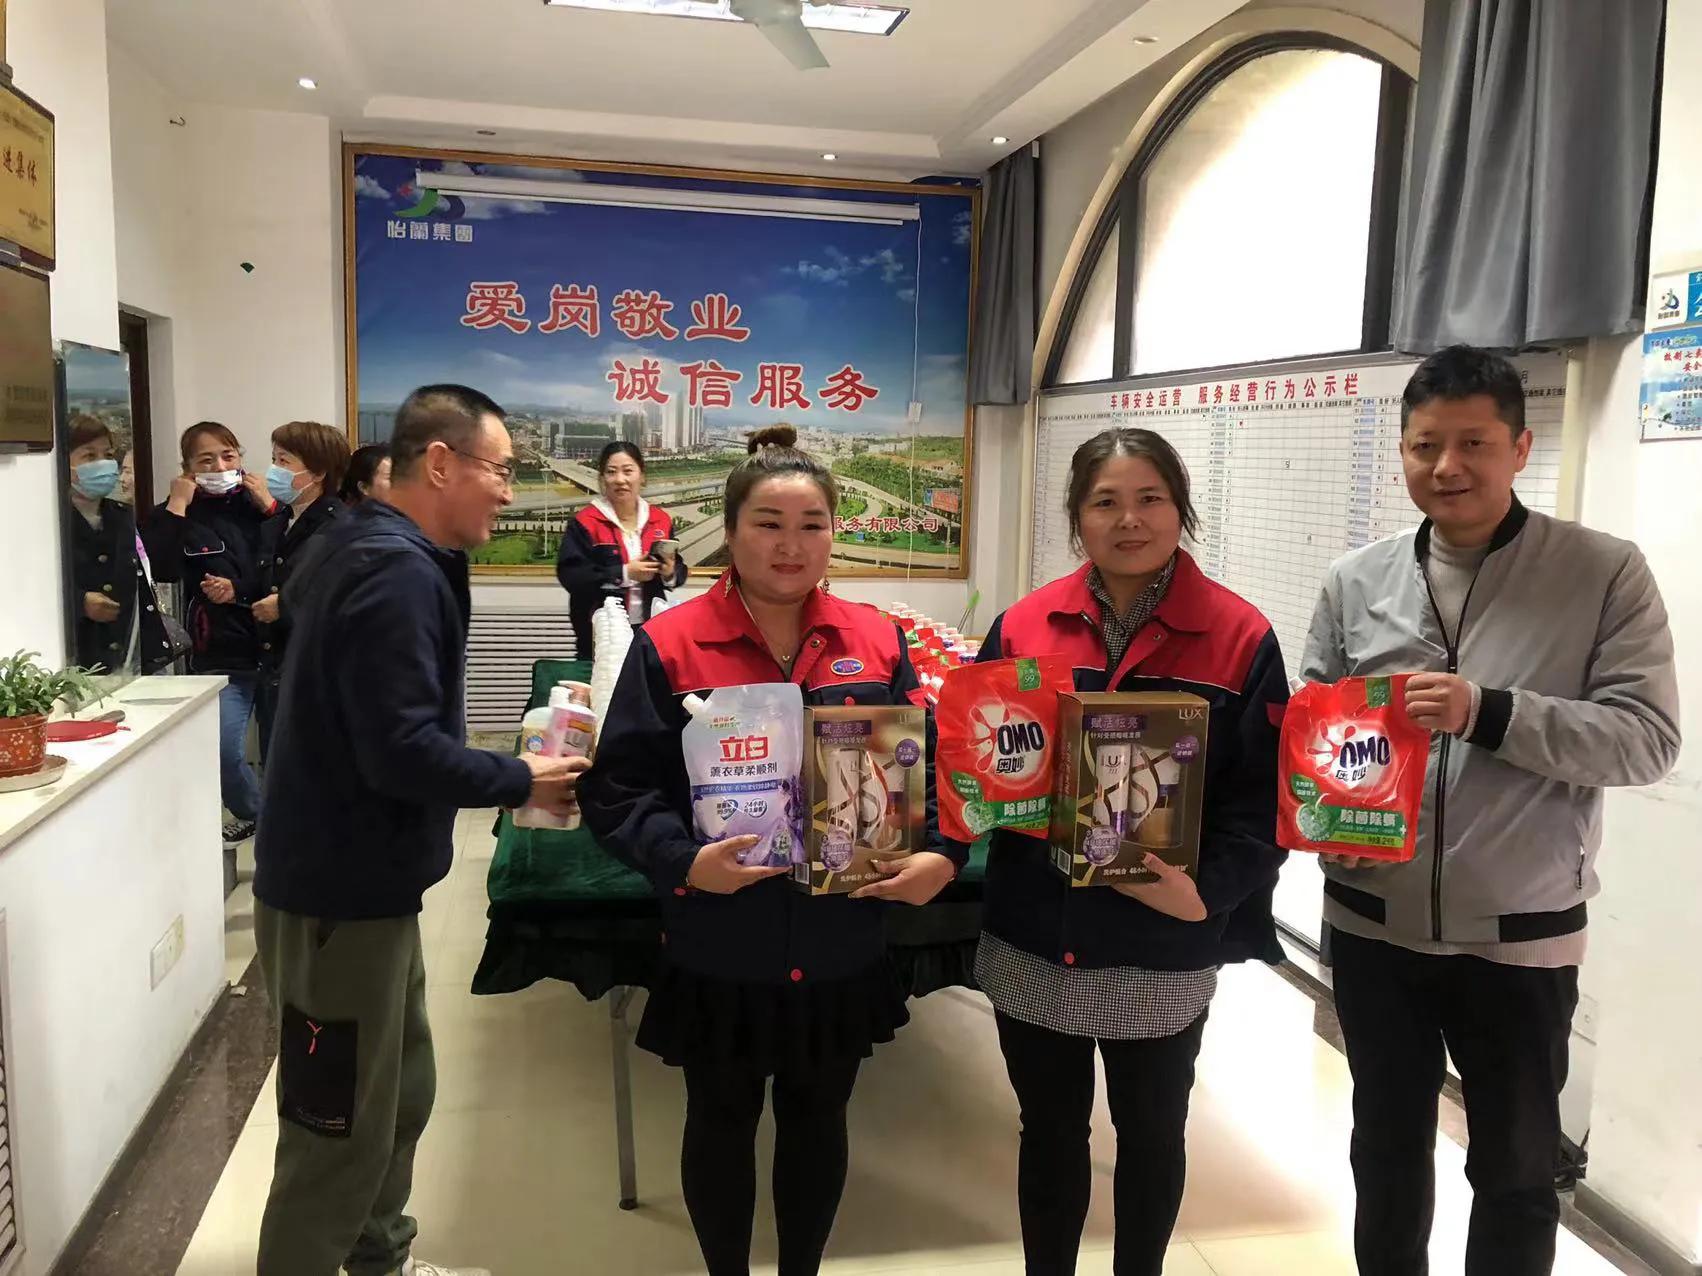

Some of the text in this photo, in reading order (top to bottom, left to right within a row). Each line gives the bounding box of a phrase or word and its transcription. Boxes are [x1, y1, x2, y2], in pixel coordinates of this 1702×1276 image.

[460, 281, 751, 342] 爱岗敬业
[606, 358, 880, 411] 诚信服务
[1111, 388, 1182, 410] 车辆安全运营
[1198, 373, 1358, 404] 服务经营行为公示栏
[832, 514, 939, 532] 服务有限公司
[1178, 708, 1204, 720] LUX
[719, 734, 768, 762] 立白
[997, 722, 1045, 755] OMO
[1340, 736, 1390, 768] OMO
[710, 762, 777, 777] 薰衣草柔顺剂
[1340, 809, 1396, 826] 除菌除螨
